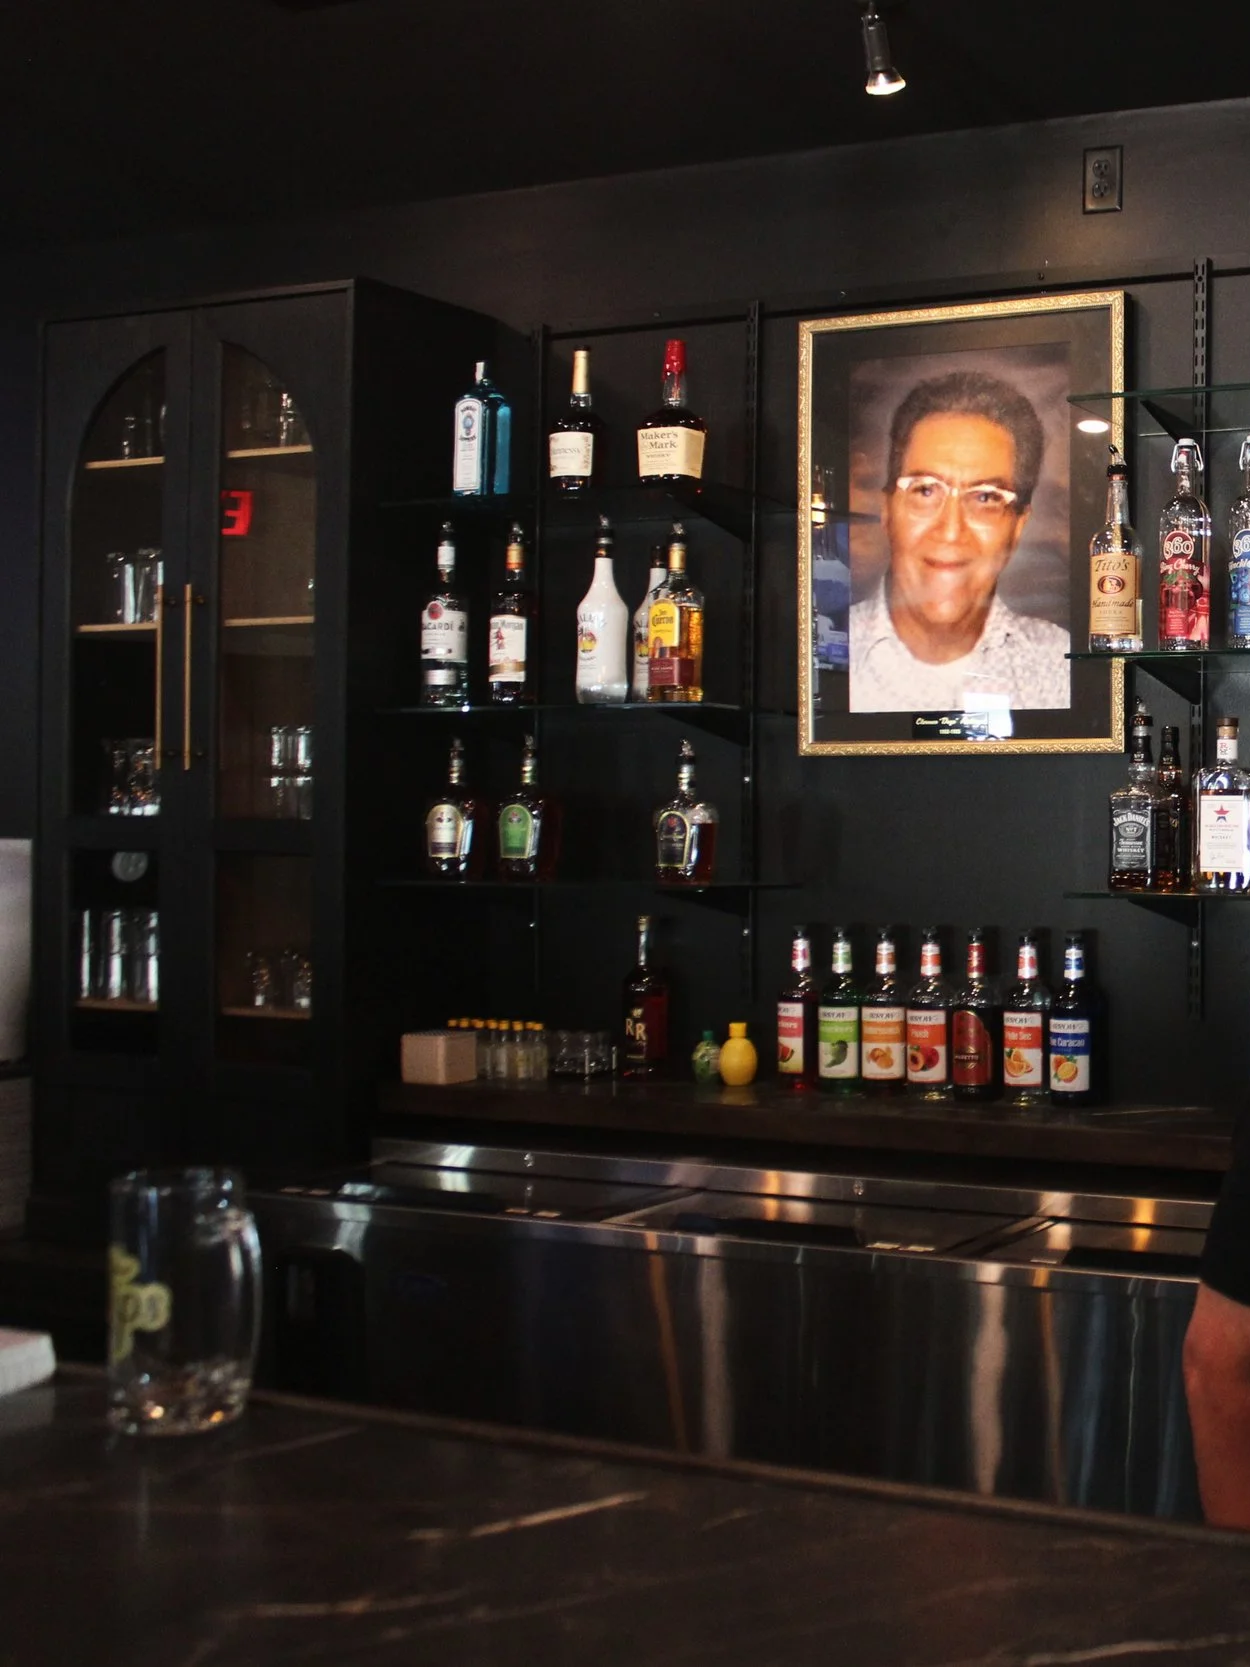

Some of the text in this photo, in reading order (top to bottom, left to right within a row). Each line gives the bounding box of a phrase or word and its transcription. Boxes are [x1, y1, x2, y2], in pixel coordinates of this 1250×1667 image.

[640, 431, 679, 440] Maker's
[649, 440, 678, 449] Mark
[1164, 536, 1194, 558] 360
[1095, 558, 1131, 573] Tito's
[1092, 597, 1135, 609] Handmade
